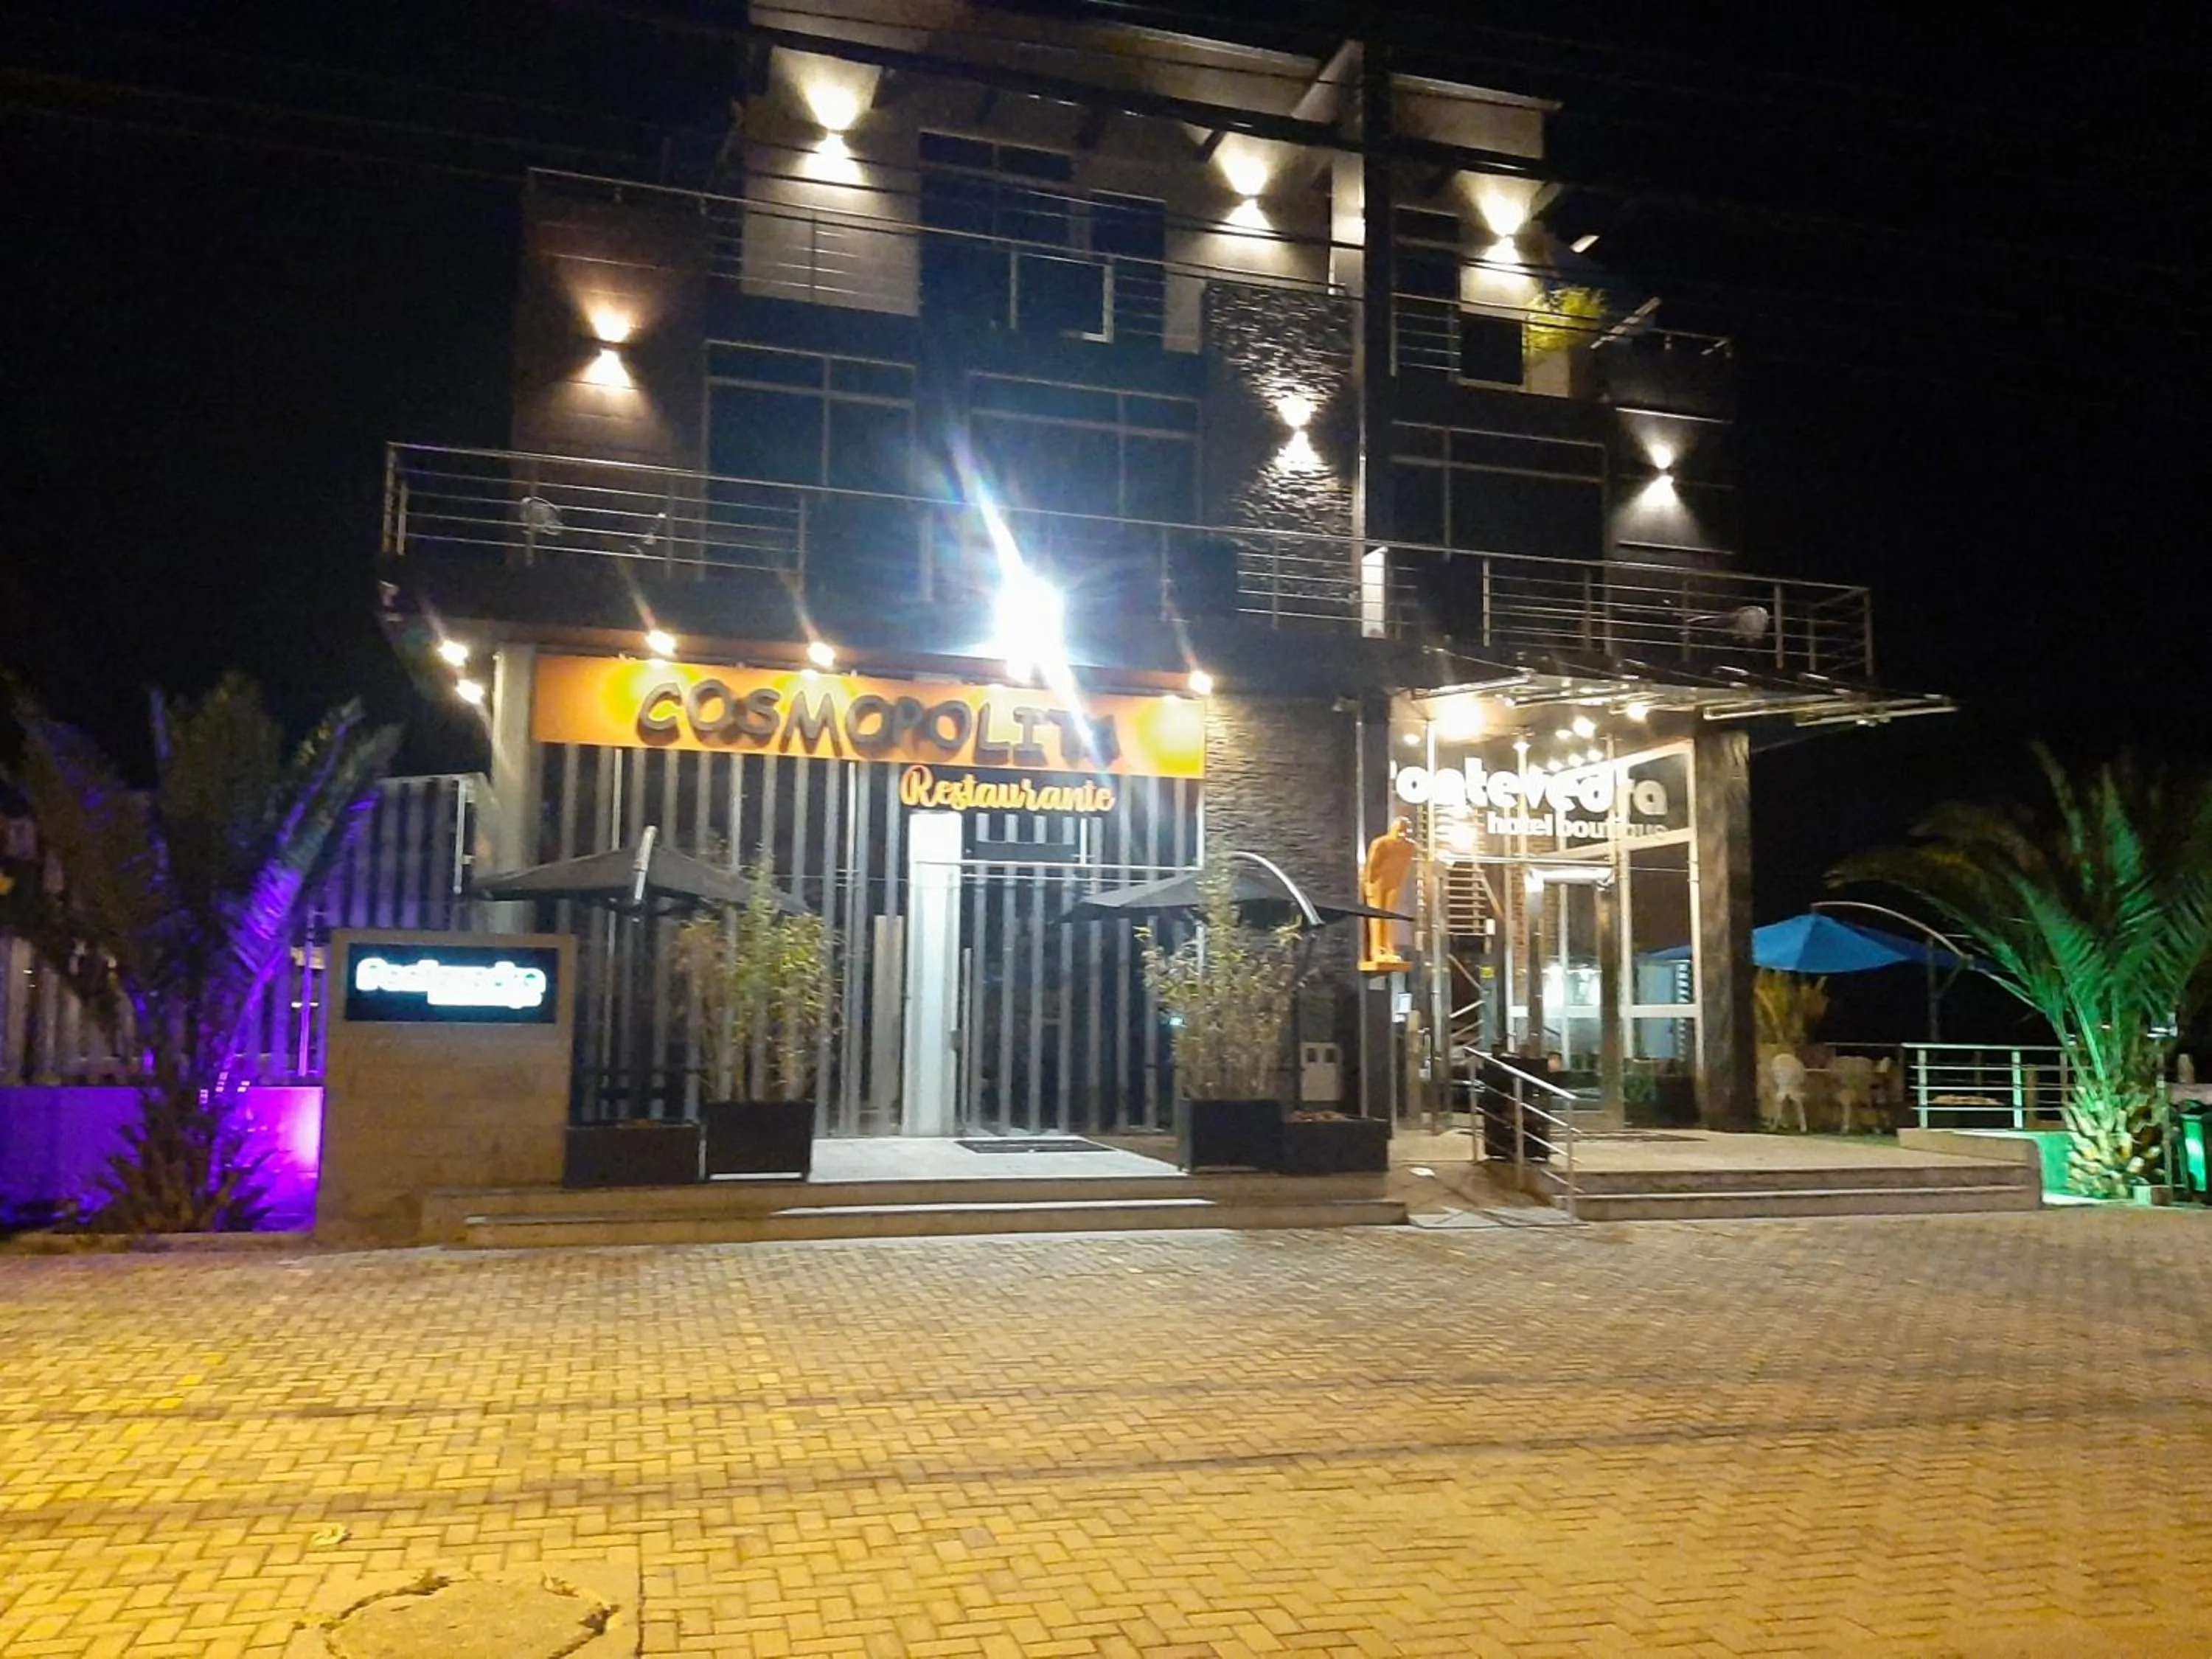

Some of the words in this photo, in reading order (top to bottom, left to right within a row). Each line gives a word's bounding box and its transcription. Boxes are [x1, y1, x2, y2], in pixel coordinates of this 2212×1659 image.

[900, 765, 1116, 811] Restaurante
[1389, 757, 1668, 815] ontevedra
[1487, 810, 1554, 835] hotel
